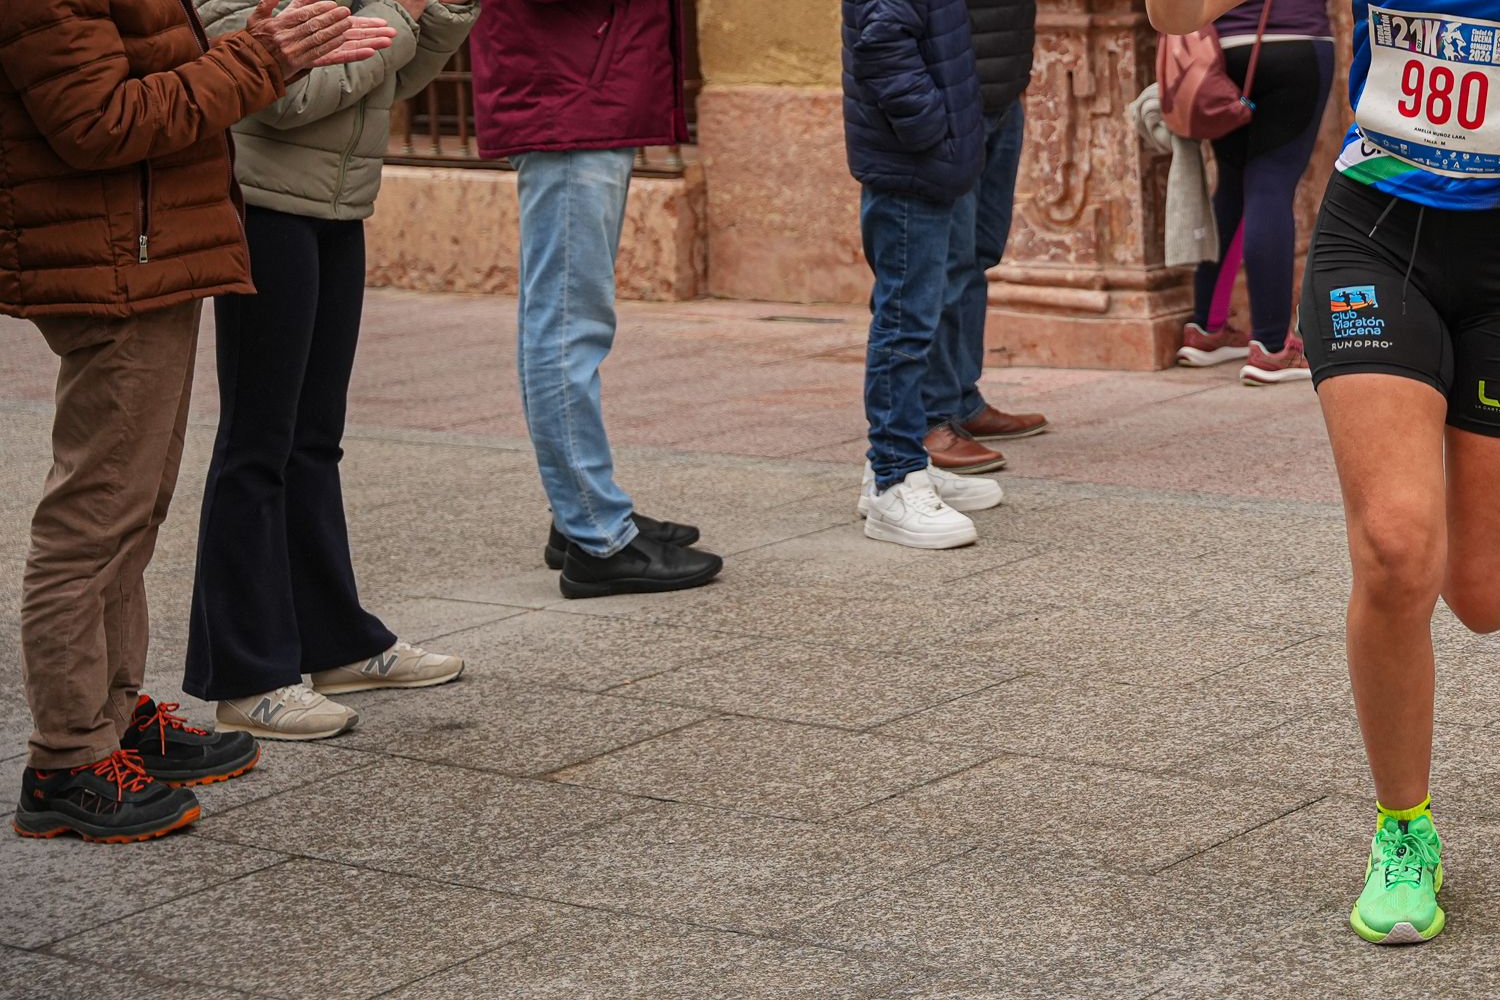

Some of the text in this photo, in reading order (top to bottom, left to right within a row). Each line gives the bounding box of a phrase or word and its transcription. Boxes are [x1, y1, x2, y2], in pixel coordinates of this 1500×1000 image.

[1391, 16, 1441, 56] 21K
[1468, 50, 1491, 63] 2026
[1397, 59, 1489, 130] 980
[1331, 310, 1357, 321] Club
[1333, 316, 1385, 329] Maratón
[1334, 326, 1382, 338] Lucena
[250, 696, 285, 725] N
